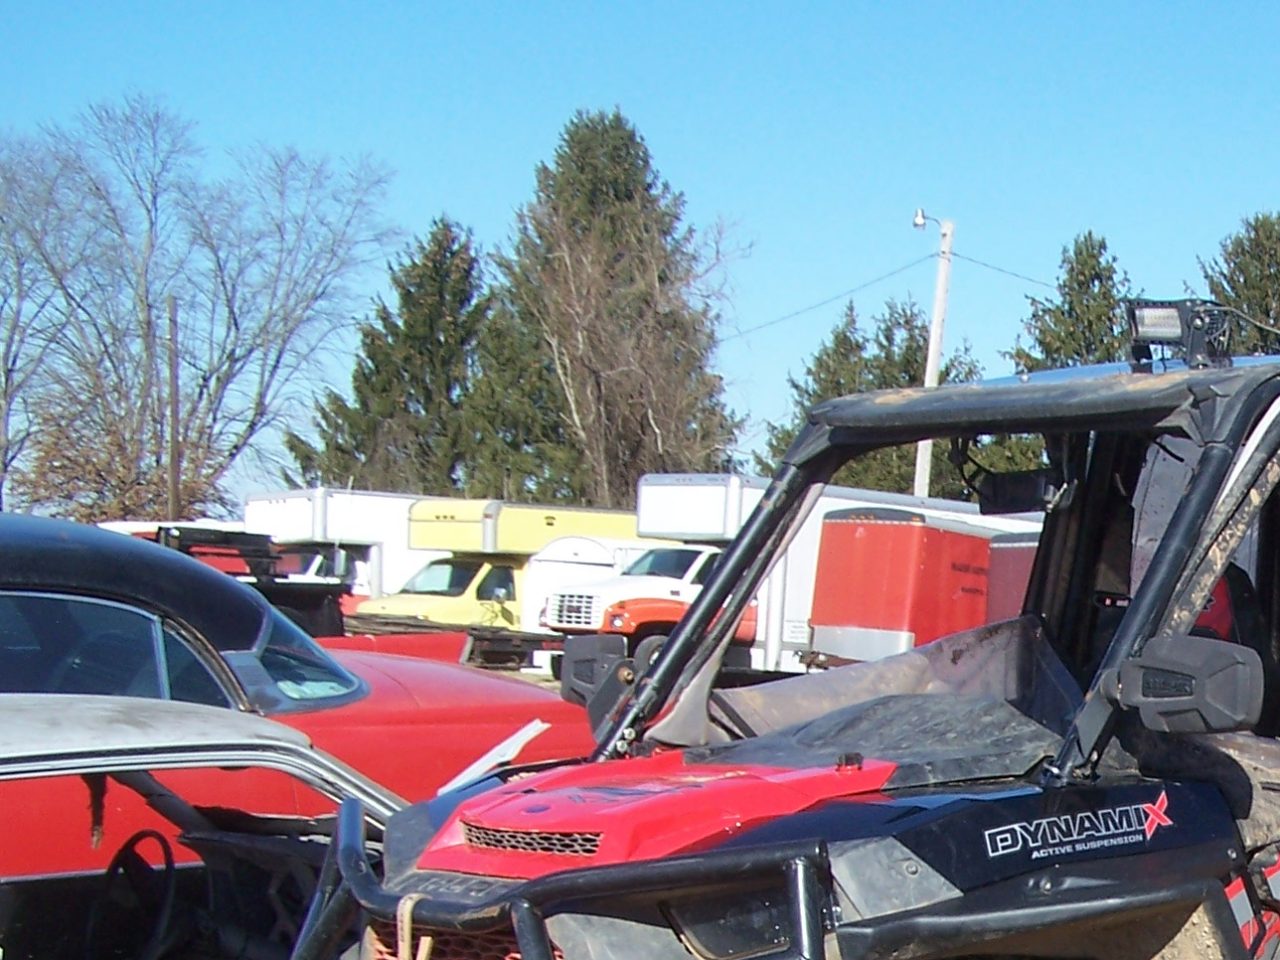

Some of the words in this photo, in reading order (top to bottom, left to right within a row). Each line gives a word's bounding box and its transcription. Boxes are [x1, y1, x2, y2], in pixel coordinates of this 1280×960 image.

[984, 790, 1174, 857] DYNAMIX
[1031, 845, 1073, 860] ACTIVE
[1075, 834, 1144, 851] SUSPENSION
